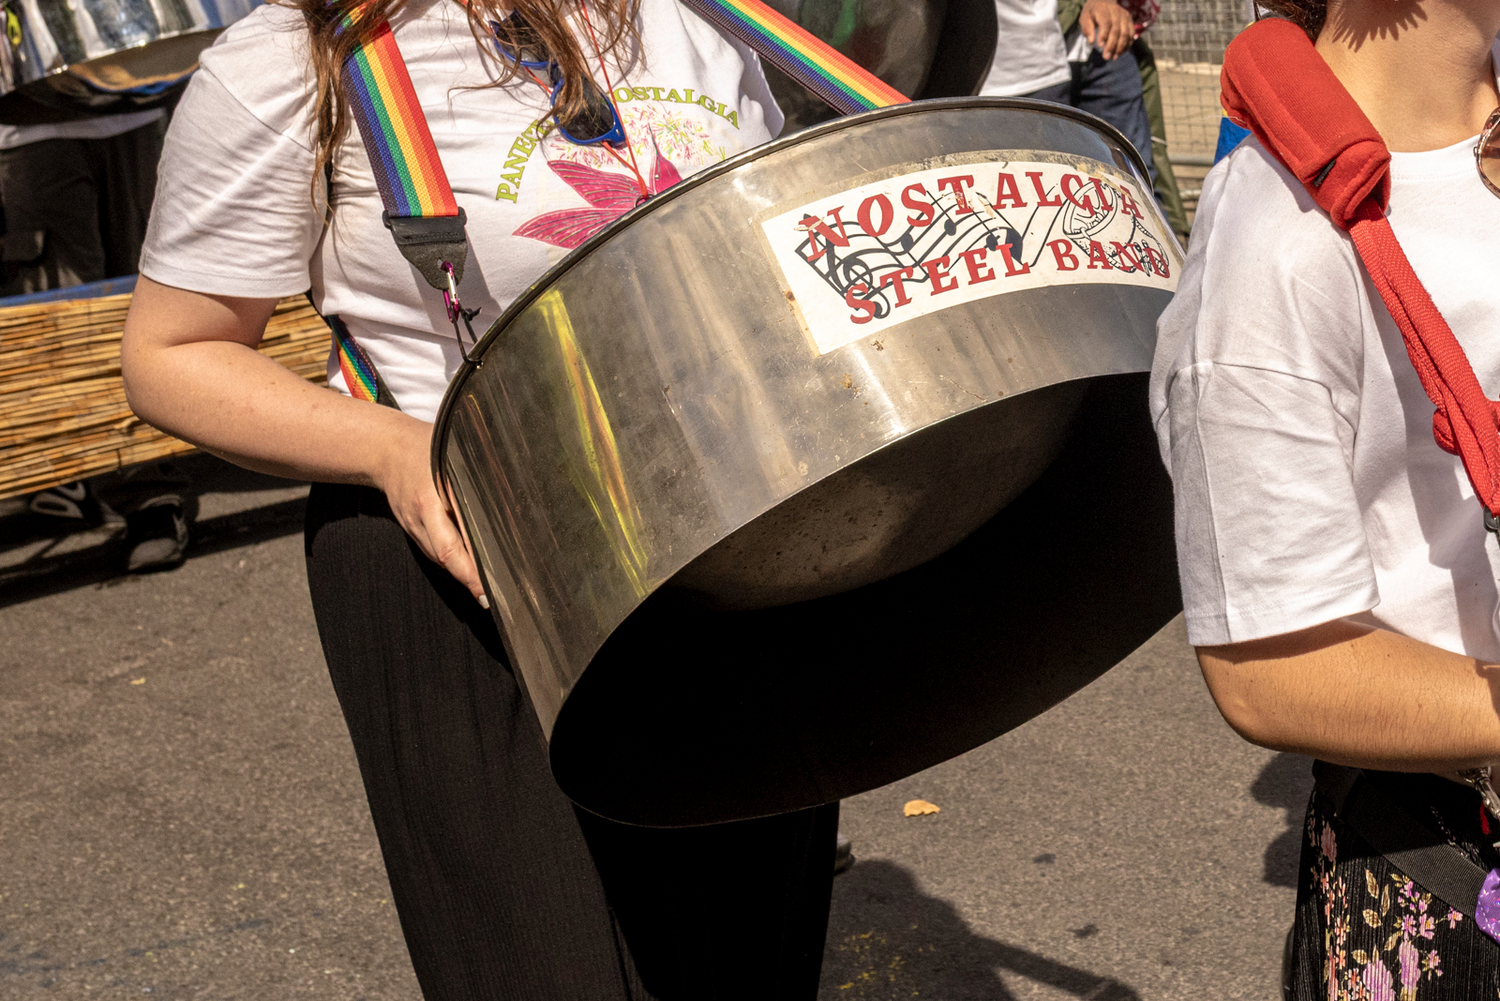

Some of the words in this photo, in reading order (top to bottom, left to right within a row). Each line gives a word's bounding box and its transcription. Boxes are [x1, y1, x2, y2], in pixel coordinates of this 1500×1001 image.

[798, 171, 1145, 262] NOSTALGIA
[845, 243, 1031, 325] STEEL
[1046, 238, 1170, 278] BAND
